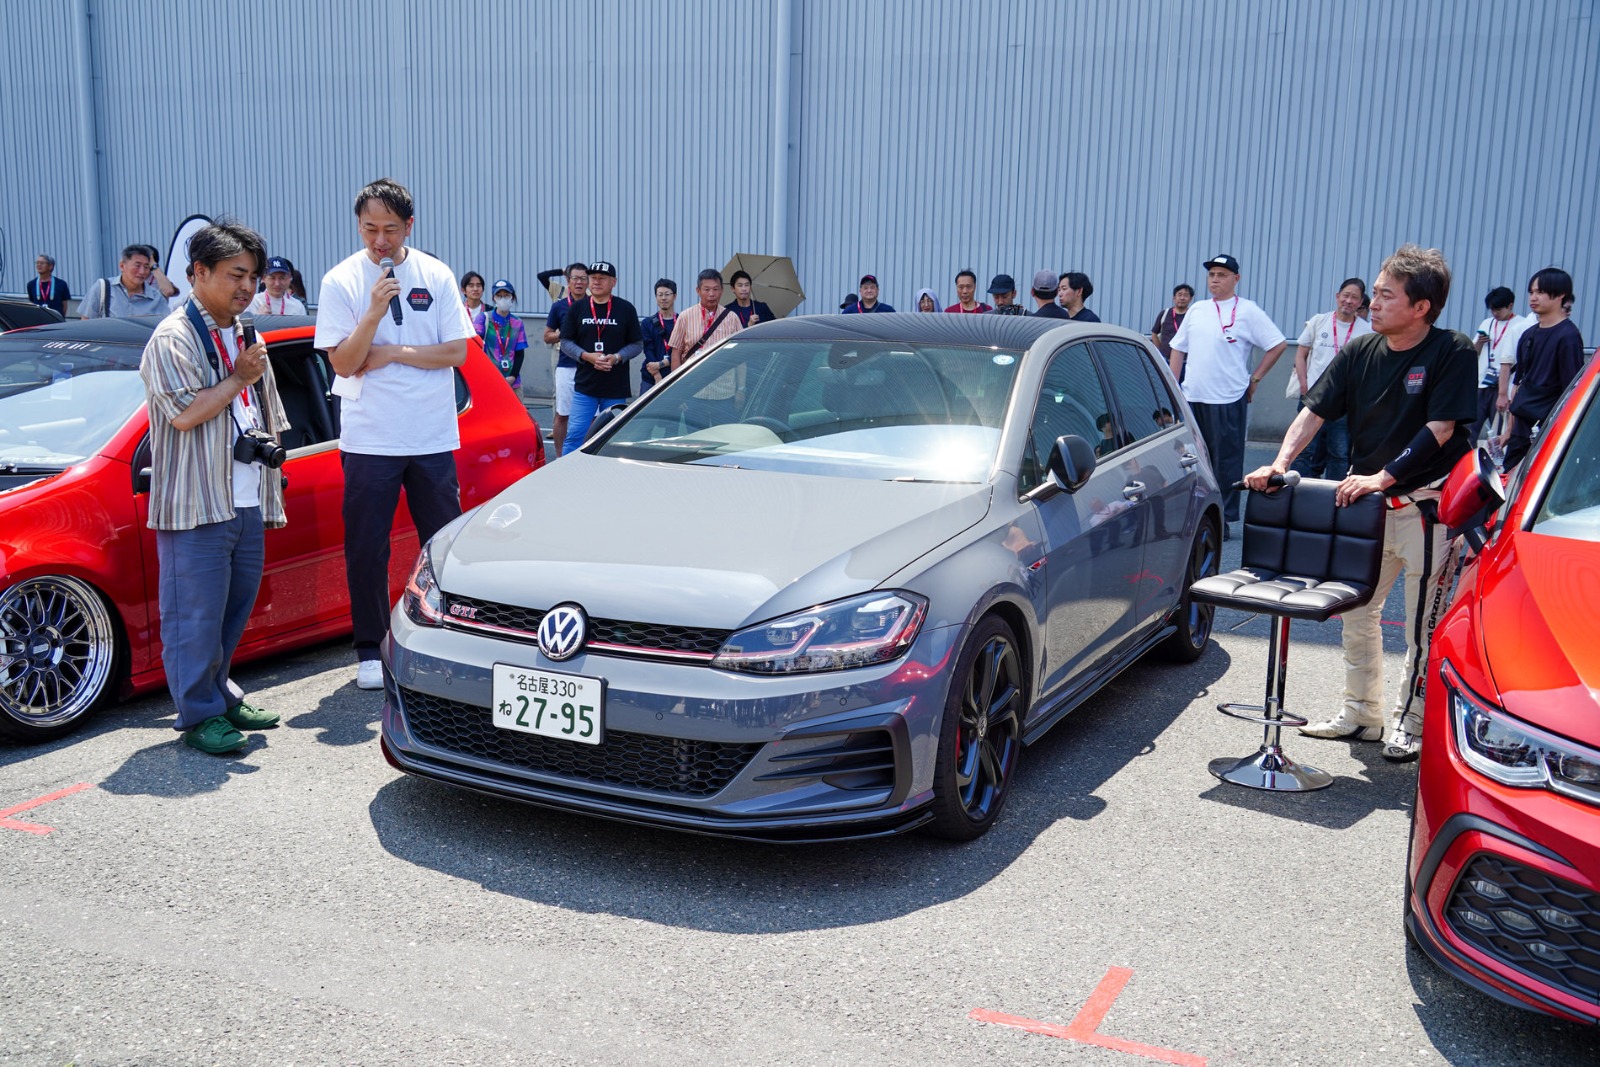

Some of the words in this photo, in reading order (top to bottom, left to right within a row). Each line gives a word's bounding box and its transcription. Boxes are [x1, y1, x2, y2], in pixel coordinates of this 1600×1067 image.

[450, 604, 477, 619] GTI
[1428, 587, 1442, 630] GAZOO
[516, 674, 577, 698] 名古屋330
[499, 700, 512, 716] ね
[516, 695, 594, 738] 27-95
